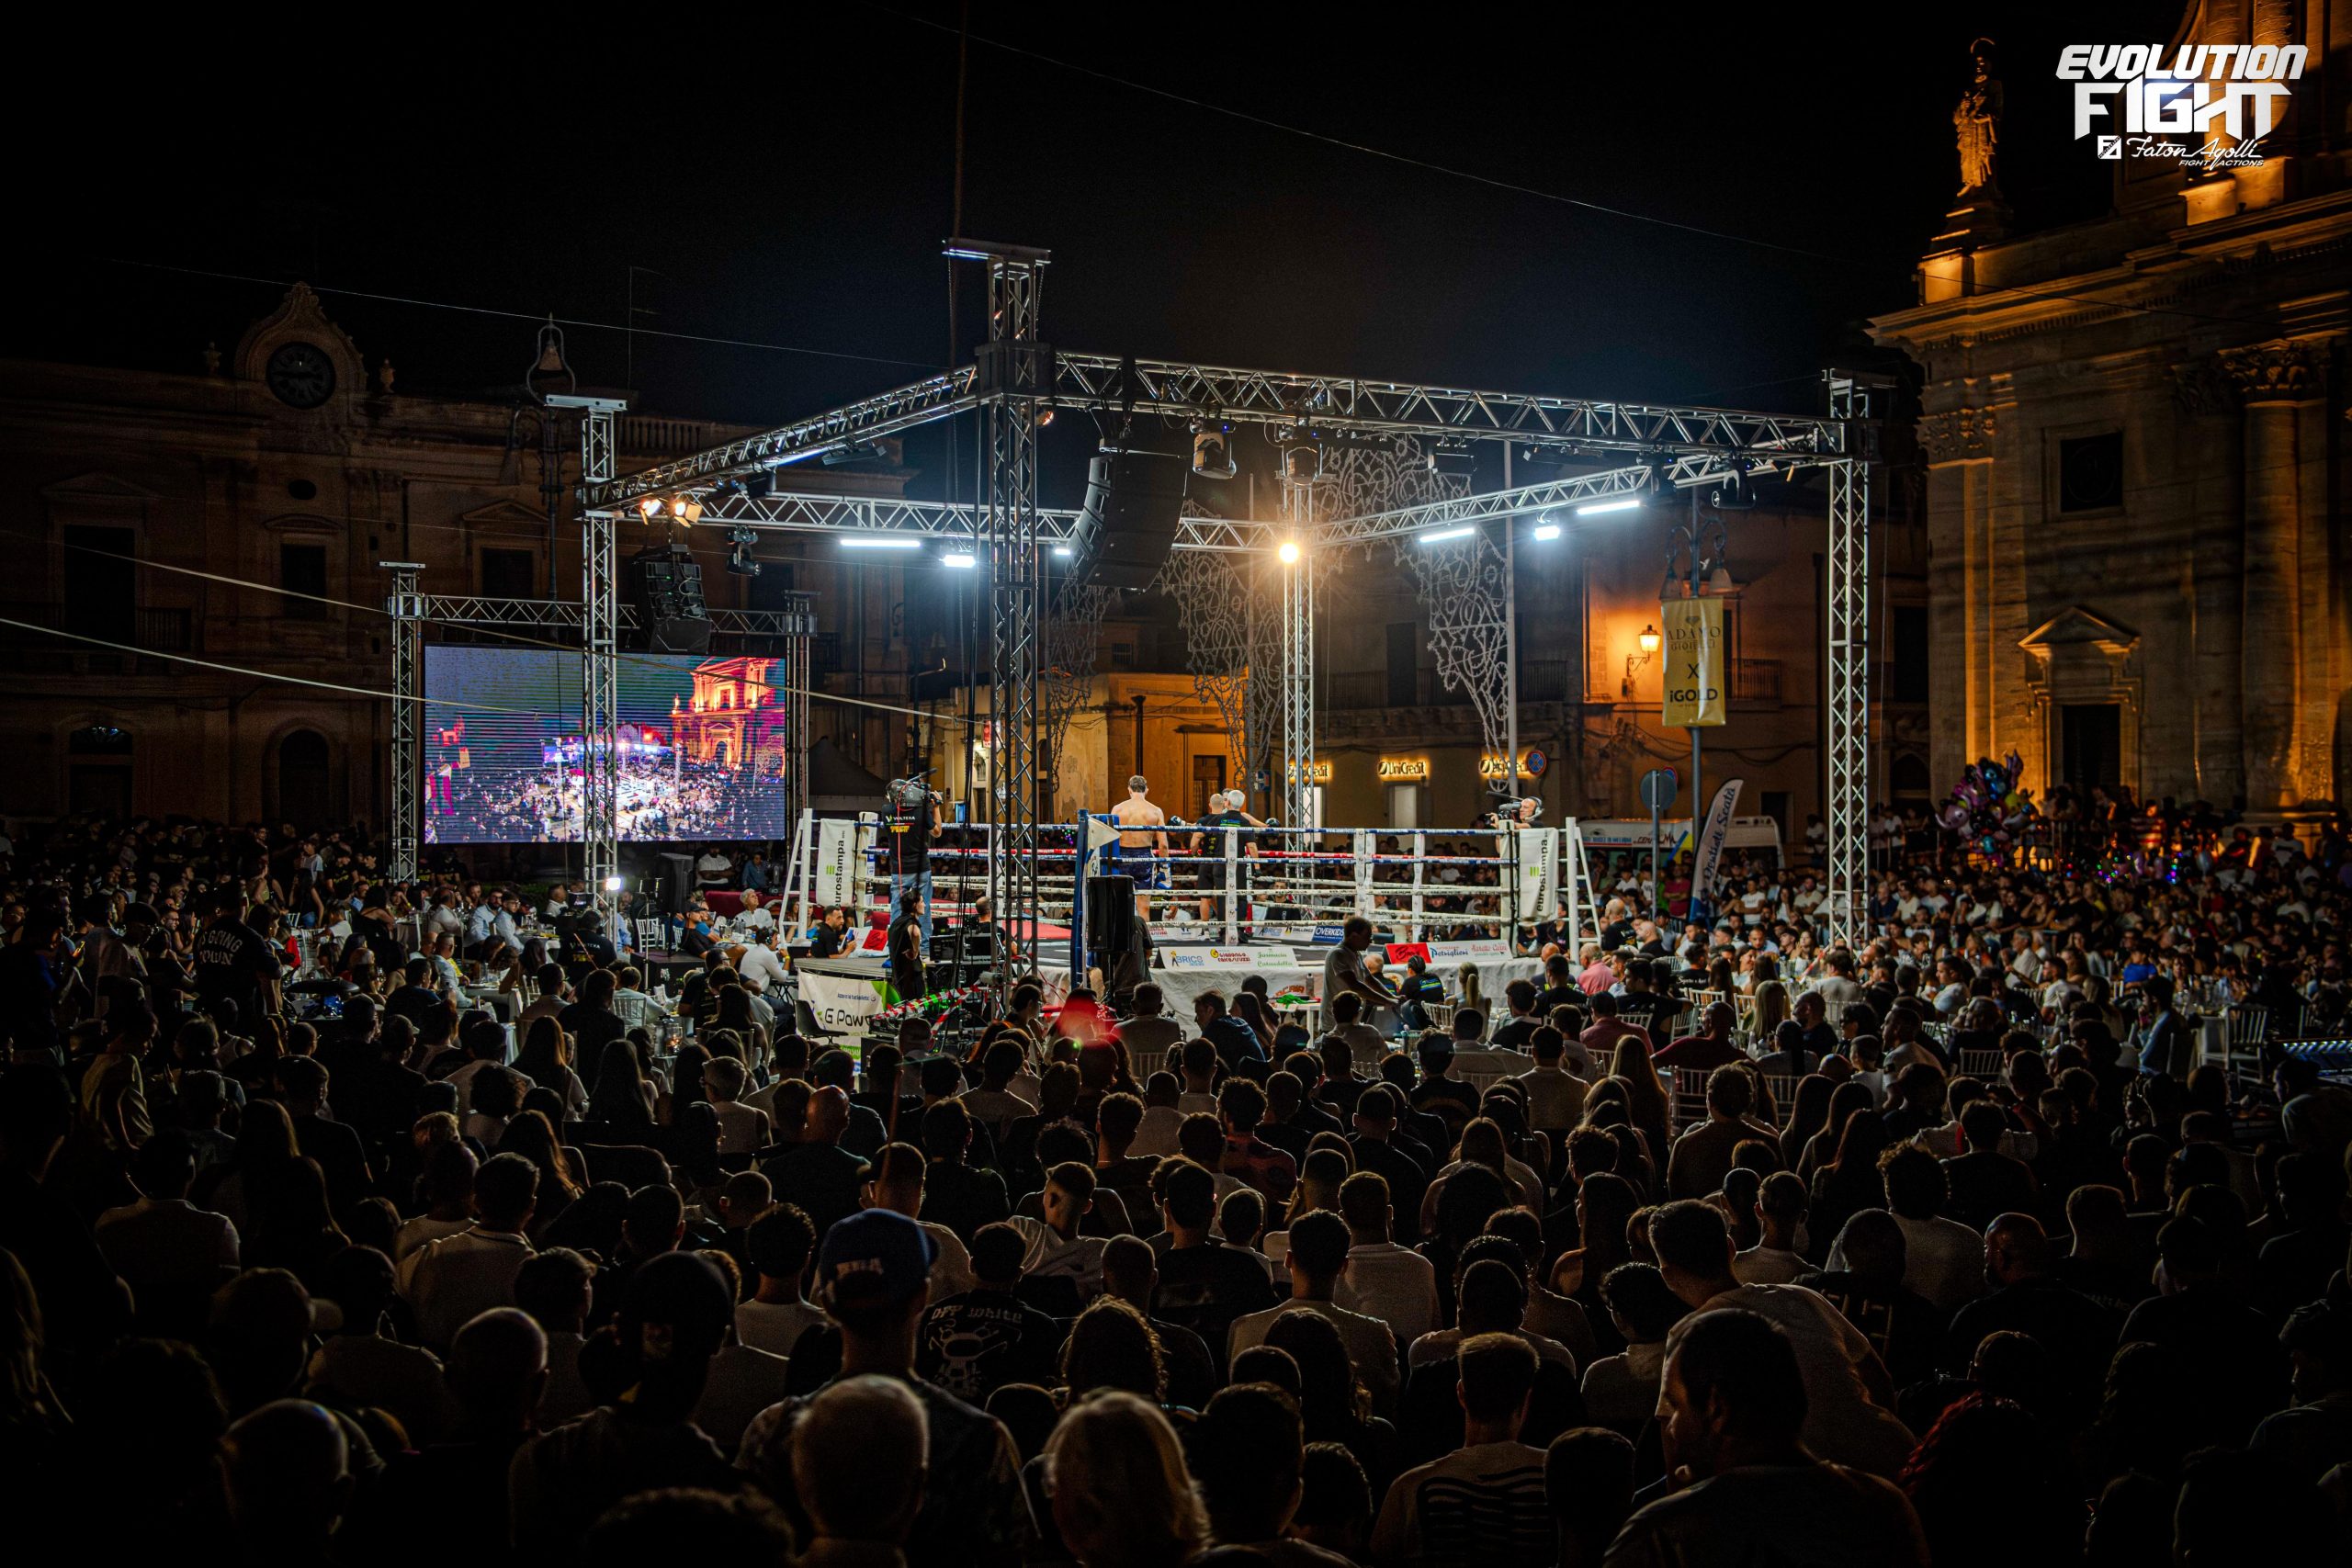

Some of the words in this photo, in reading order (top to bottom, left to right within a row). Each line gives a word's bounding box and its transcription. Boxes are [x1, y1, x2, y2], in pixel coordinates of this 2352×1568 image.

[1388, 761, 1425, 774] UniCredit
[1536, 839, 1548, 912] eurostampa
[1316, 927, 1344, 936] OVERKIDS
[1176, 955, 1203, 964] BRICO
[825, 1009, 834, 1024] G
